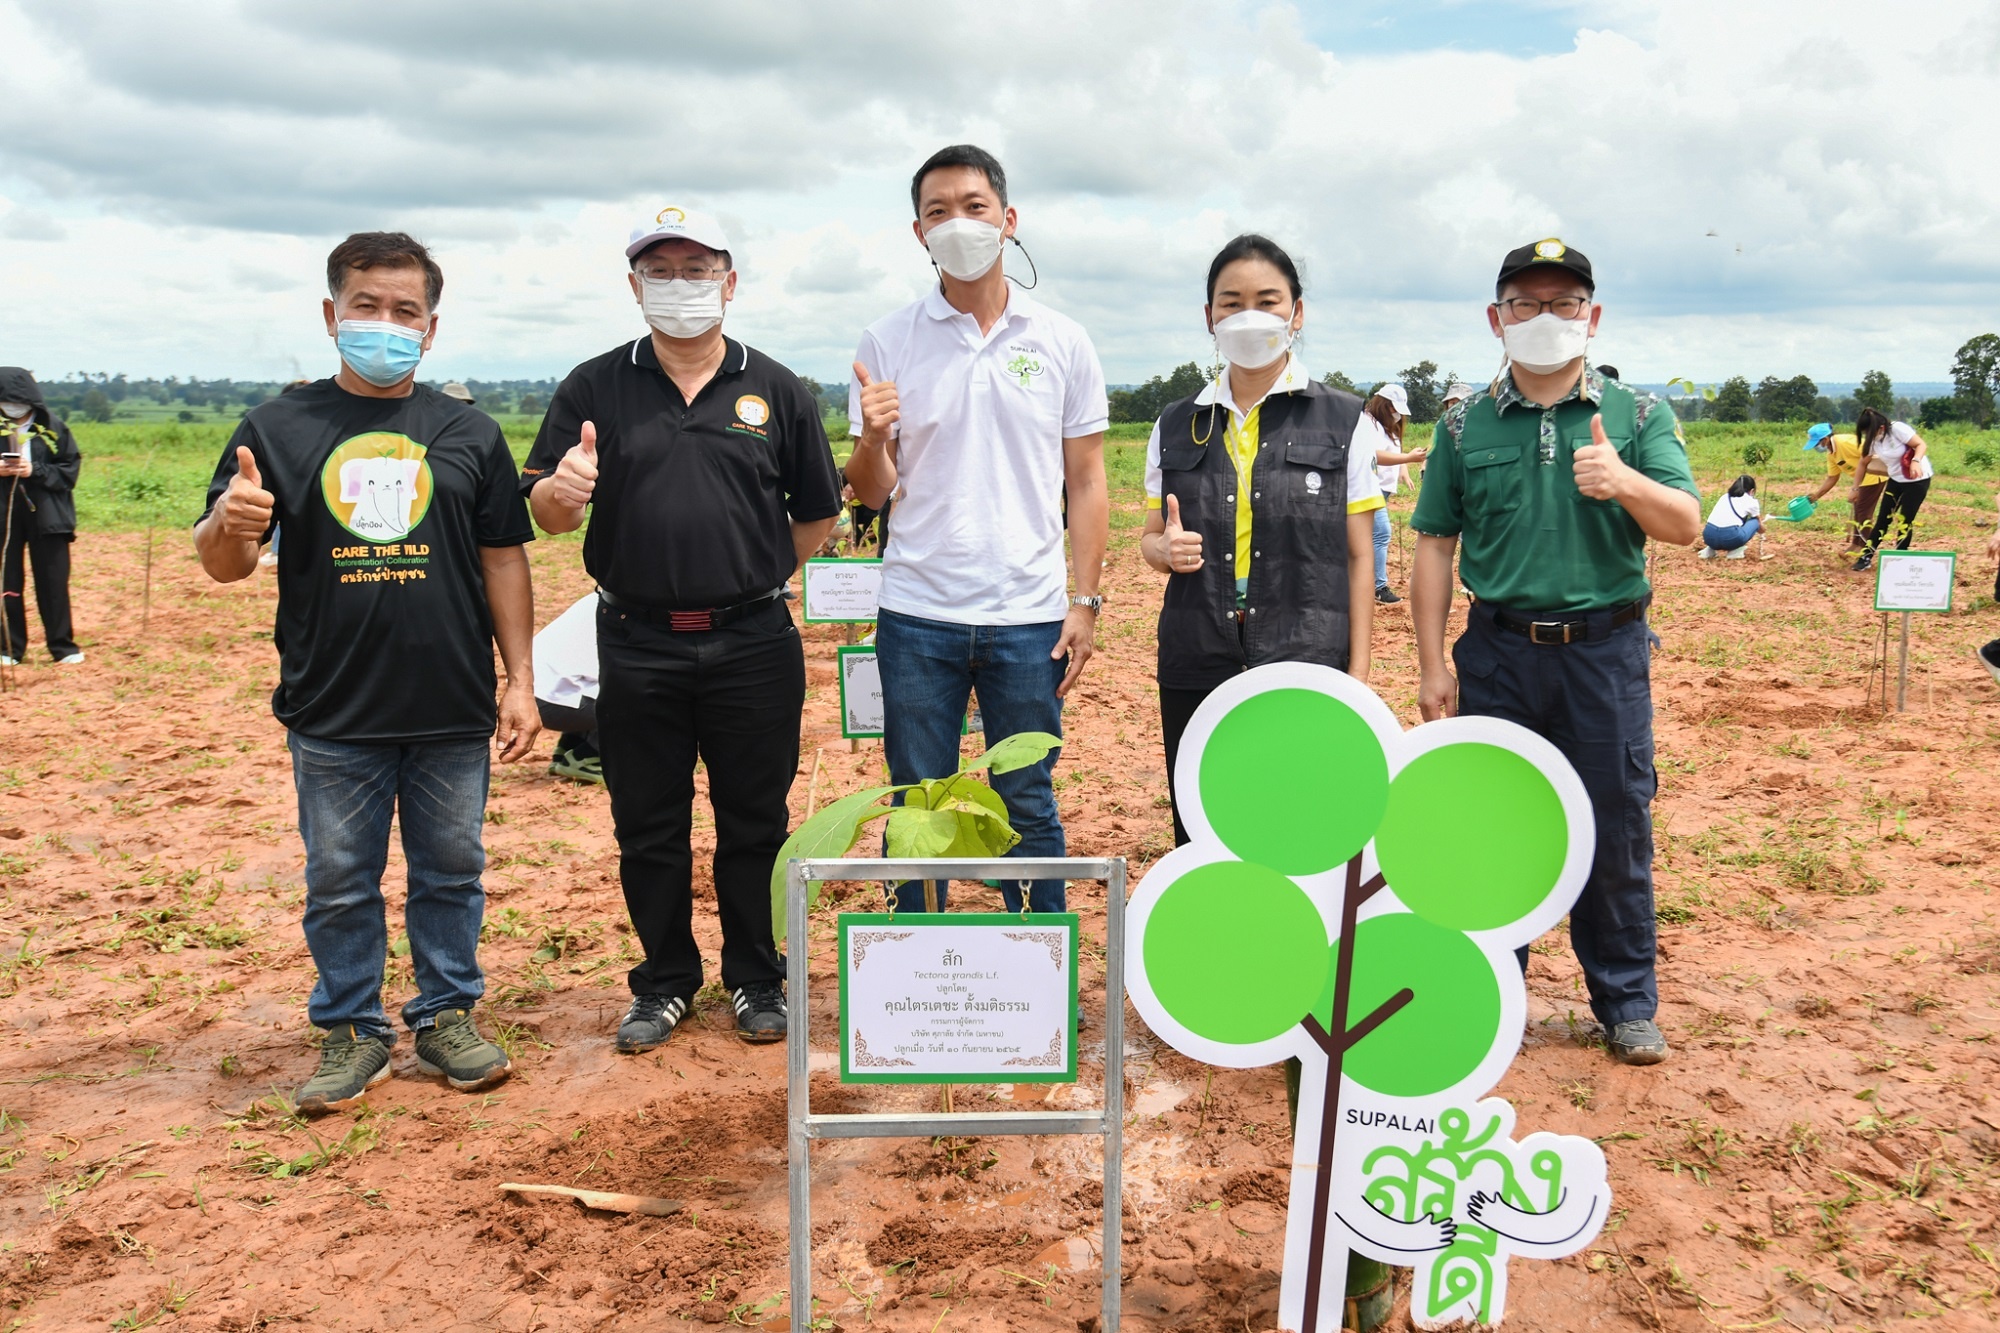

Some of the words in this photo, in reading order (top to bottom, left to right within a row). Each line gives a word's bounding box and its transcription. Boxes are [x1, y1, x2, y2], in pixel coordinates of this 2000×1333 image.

[332, 546, 369, 559] CARE
[373, 545, 400, 557] THE
[942, 949, 963, 966] สัก
[914, 971, 949, 980] Tectona
[951, 971, 983, 980] grandis
[986, 971, 999, 979] L.f.
[936, 983, 967, 995] ปลูกโดย
[885, 996, 959, 1015] คุณไตรเตชะ
[964, 993, 1030, 1012] ตั้งมติธรรม
[931, 1017, 984, 1027] กรรมการผู้จัดการ
[911, 1029, 930, 1037] บริษัท
[956, 1029, 974, 1037] จำกัด
[976, 1030, 1004, 1038] (มหาชน)
[894, 1043, 924, 1055] ปลูกเมื่อ
[928, 1042, 944, 1053] วันที่
[962, 1044, 993, 1053] กันยายน
[1346, 1108, 1434, 1134] SUPALAI
